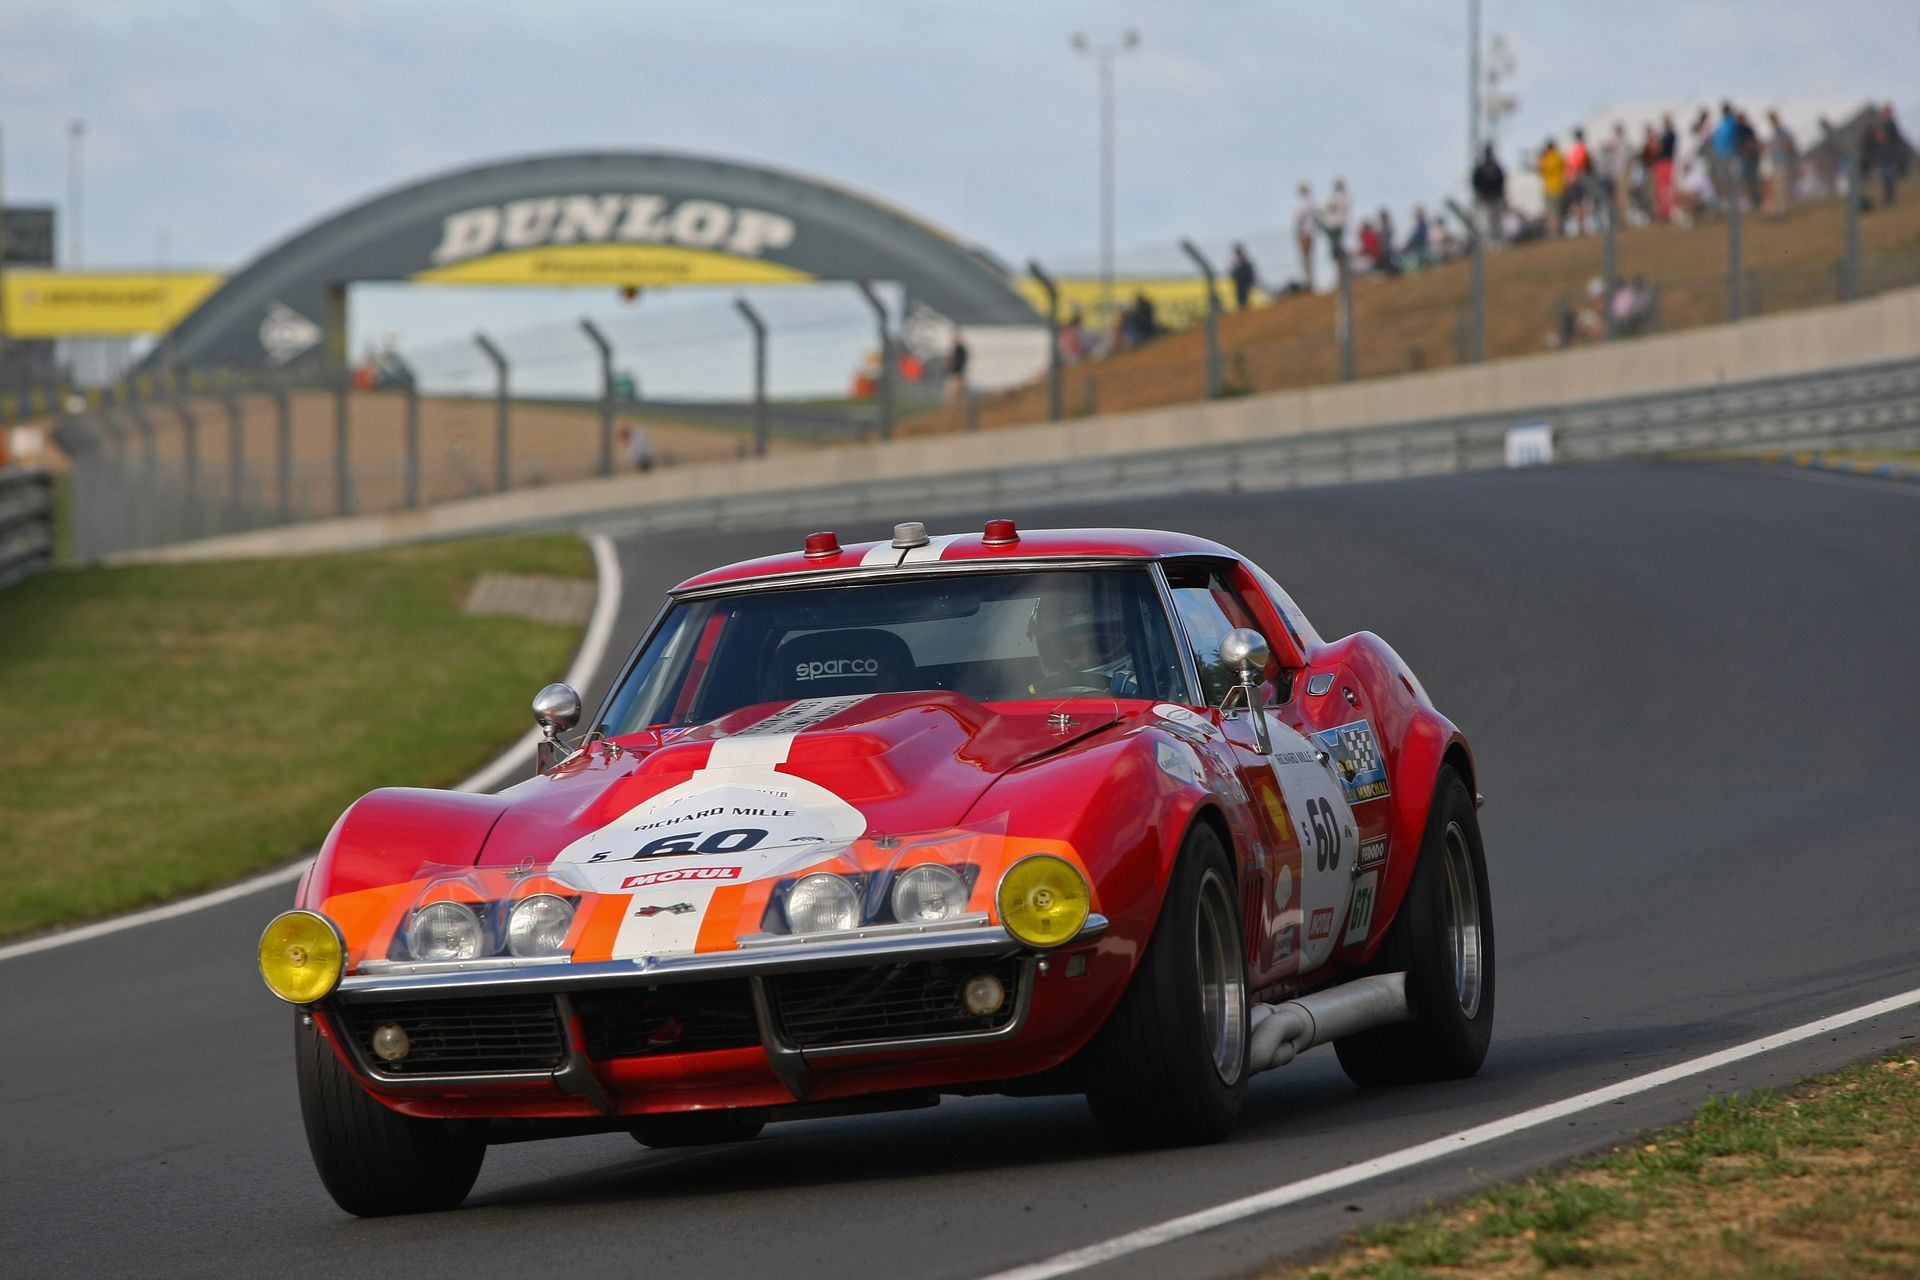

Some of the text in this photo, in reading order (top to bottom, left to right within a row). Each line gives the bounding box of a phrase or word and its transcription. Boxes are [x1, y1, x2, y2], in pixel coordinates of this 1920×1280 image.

[431, 192, 796, 264] DUNLOP
[795, 658, 879, 680] sparco
[1356, 780, 1388, 800] MARCHAL
[633, 806, 798, 832] RICHARD MILLE
[632, 828, 769, 860] 60
[1306, 796, 1341, 872] 60
[1361, 842, 1385, 862] FERODO
[626, 867, 735, 888] MOTUL
[1350, 887, 1374, 931] GT1
